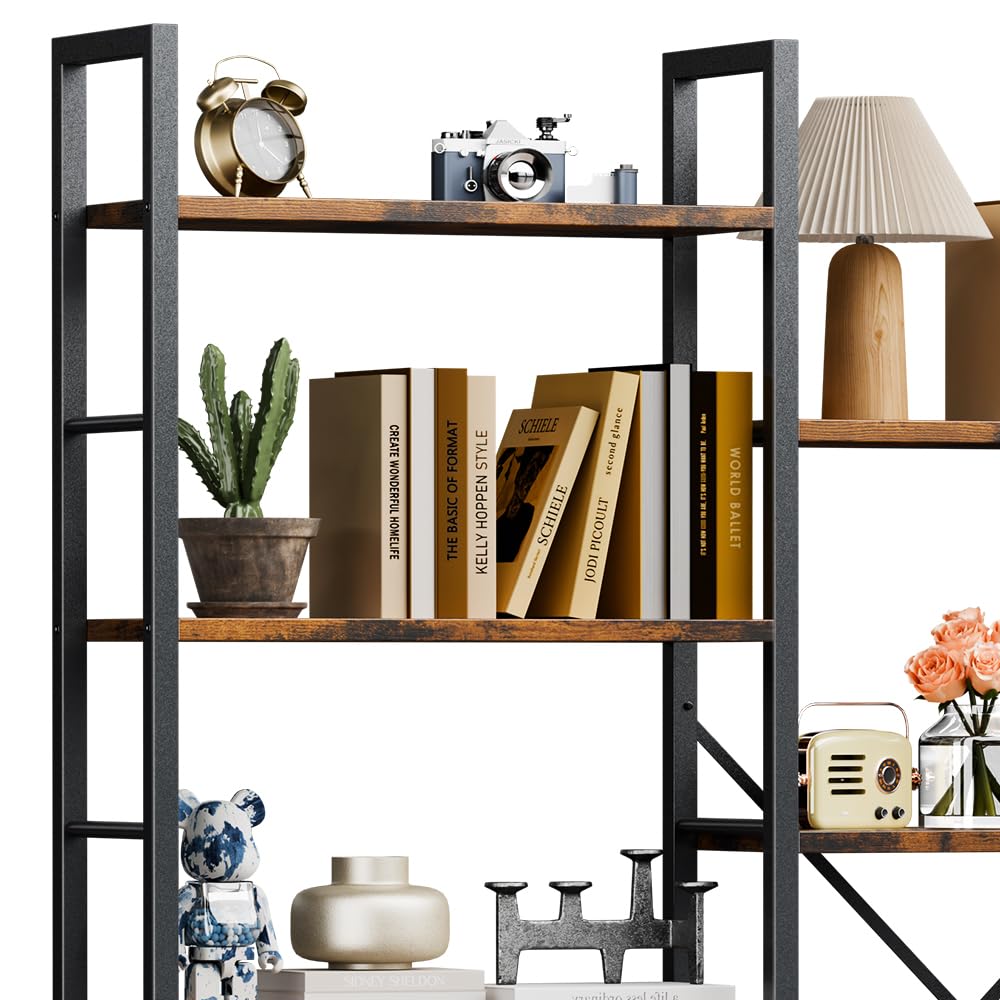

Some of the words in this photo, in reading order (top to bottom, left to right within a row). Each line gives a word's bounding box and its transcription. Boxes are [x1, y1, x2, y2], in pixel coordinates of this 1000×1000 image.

[390, 424, 400, 458] CREATE
[518, 418, 559, 434] SCHIELE
[610, 408, 623, 440] glance
[447, 420, 458, 472] FORMAT
[476, 430, 488, 470] STYLE
[606, 442, 616, 475] second
[390, 460, 400, 514] WONDERFUL
[447, 476, 458, 493] OF
[730, 448, 741, 496] WORLD
[447, 498, 458, 533] BASIC
[476, 476, 488, 529] HOPPEN
[537, 484, 568, 546] SCHIELE
[390, 516, 400, 560] HOMELIFE
[590, 497, 608, 551] PICOULT
[730, 502, 741, 548] BALLET
[447, 537, 458, 560] THE
[476, 534, 488, 574] KELLY
[584, 555, 598, 583] JODI
